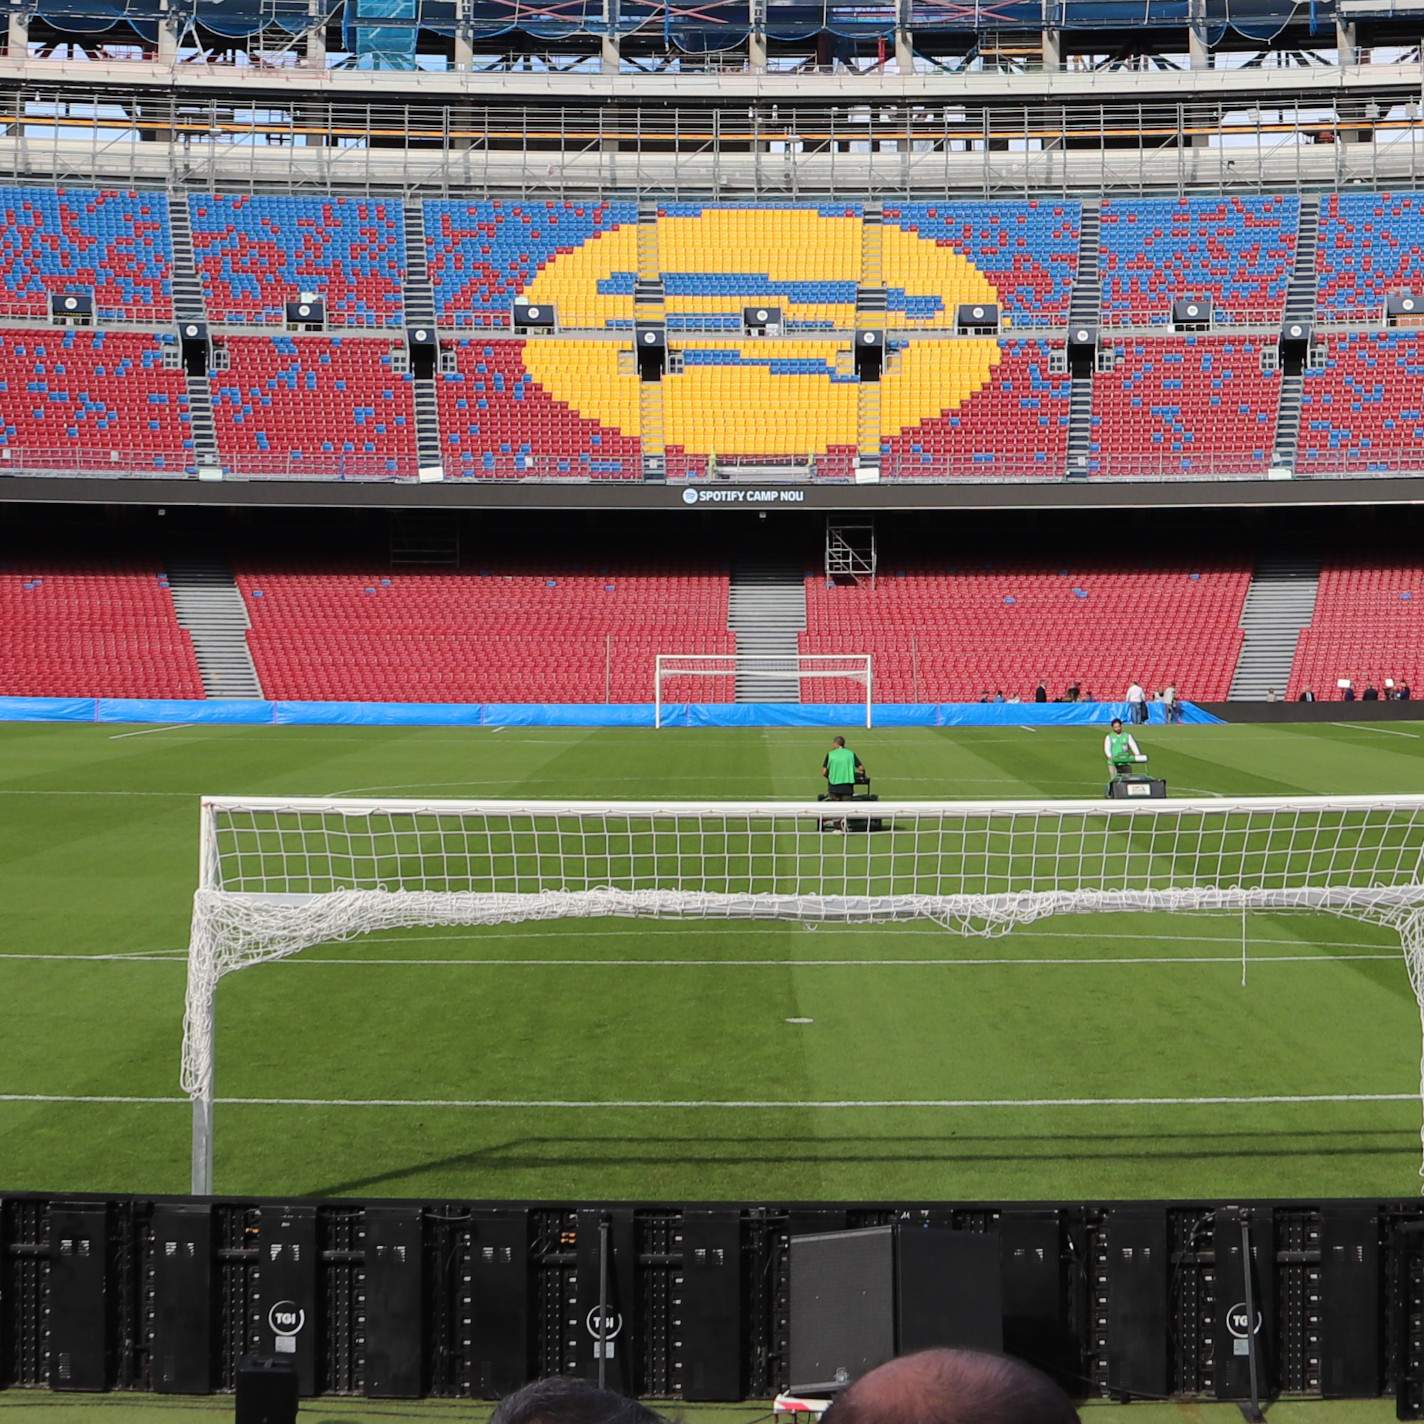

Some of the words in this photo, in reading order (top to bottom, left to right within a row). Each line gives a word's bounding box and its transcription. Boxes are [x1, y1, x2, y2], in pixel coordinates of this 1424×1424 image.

[699, 490, 744, 502] SPOTIFY
[746, 490, 778, 502] CAMP
[780, 490, 804, 502] NOU
[275, 1313, 296, 1324] TGI
